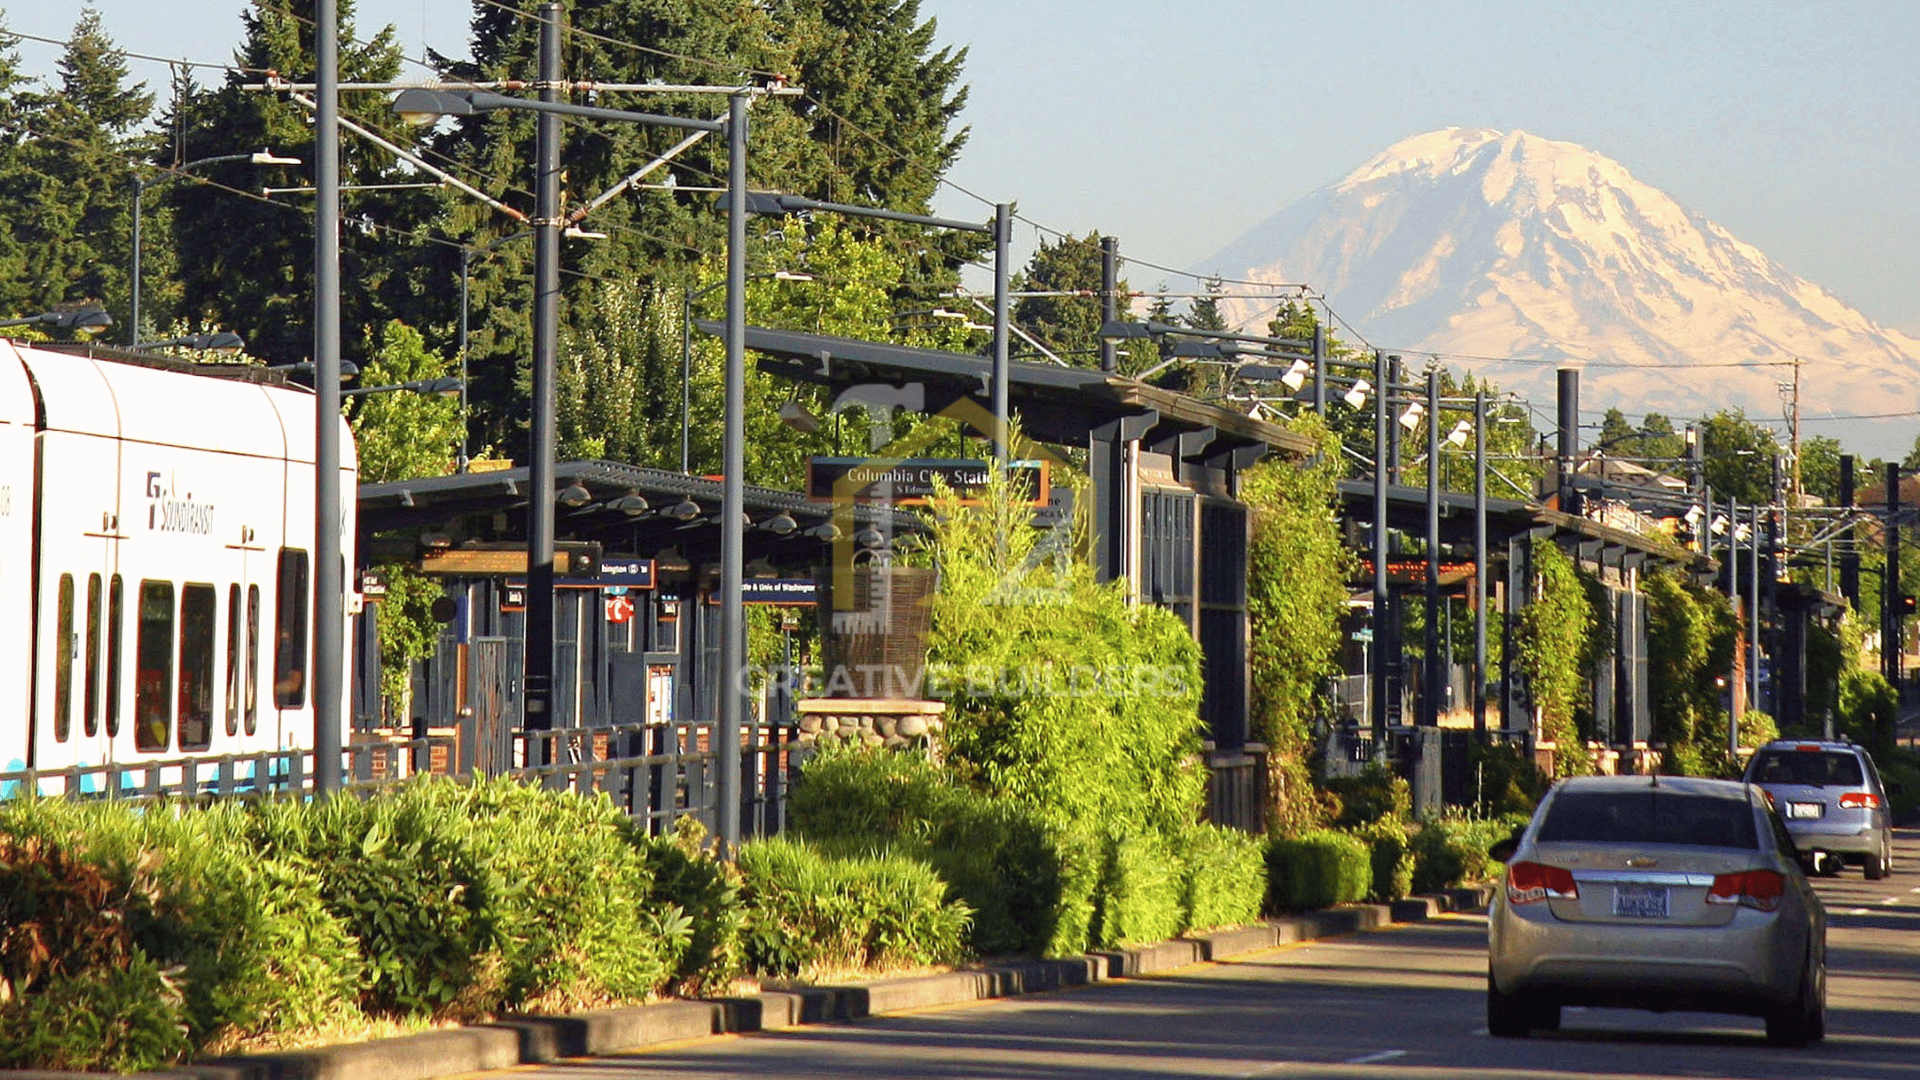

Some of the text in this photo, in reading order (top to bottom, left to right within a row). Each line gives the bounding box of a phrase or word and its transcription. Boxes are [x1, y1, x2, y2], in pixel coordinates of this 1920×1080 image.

[847, 467, 993, 485] Columbia Ciy Statio
[601, 563, 628, 575] hington
[774, 583, 781, 591] of
